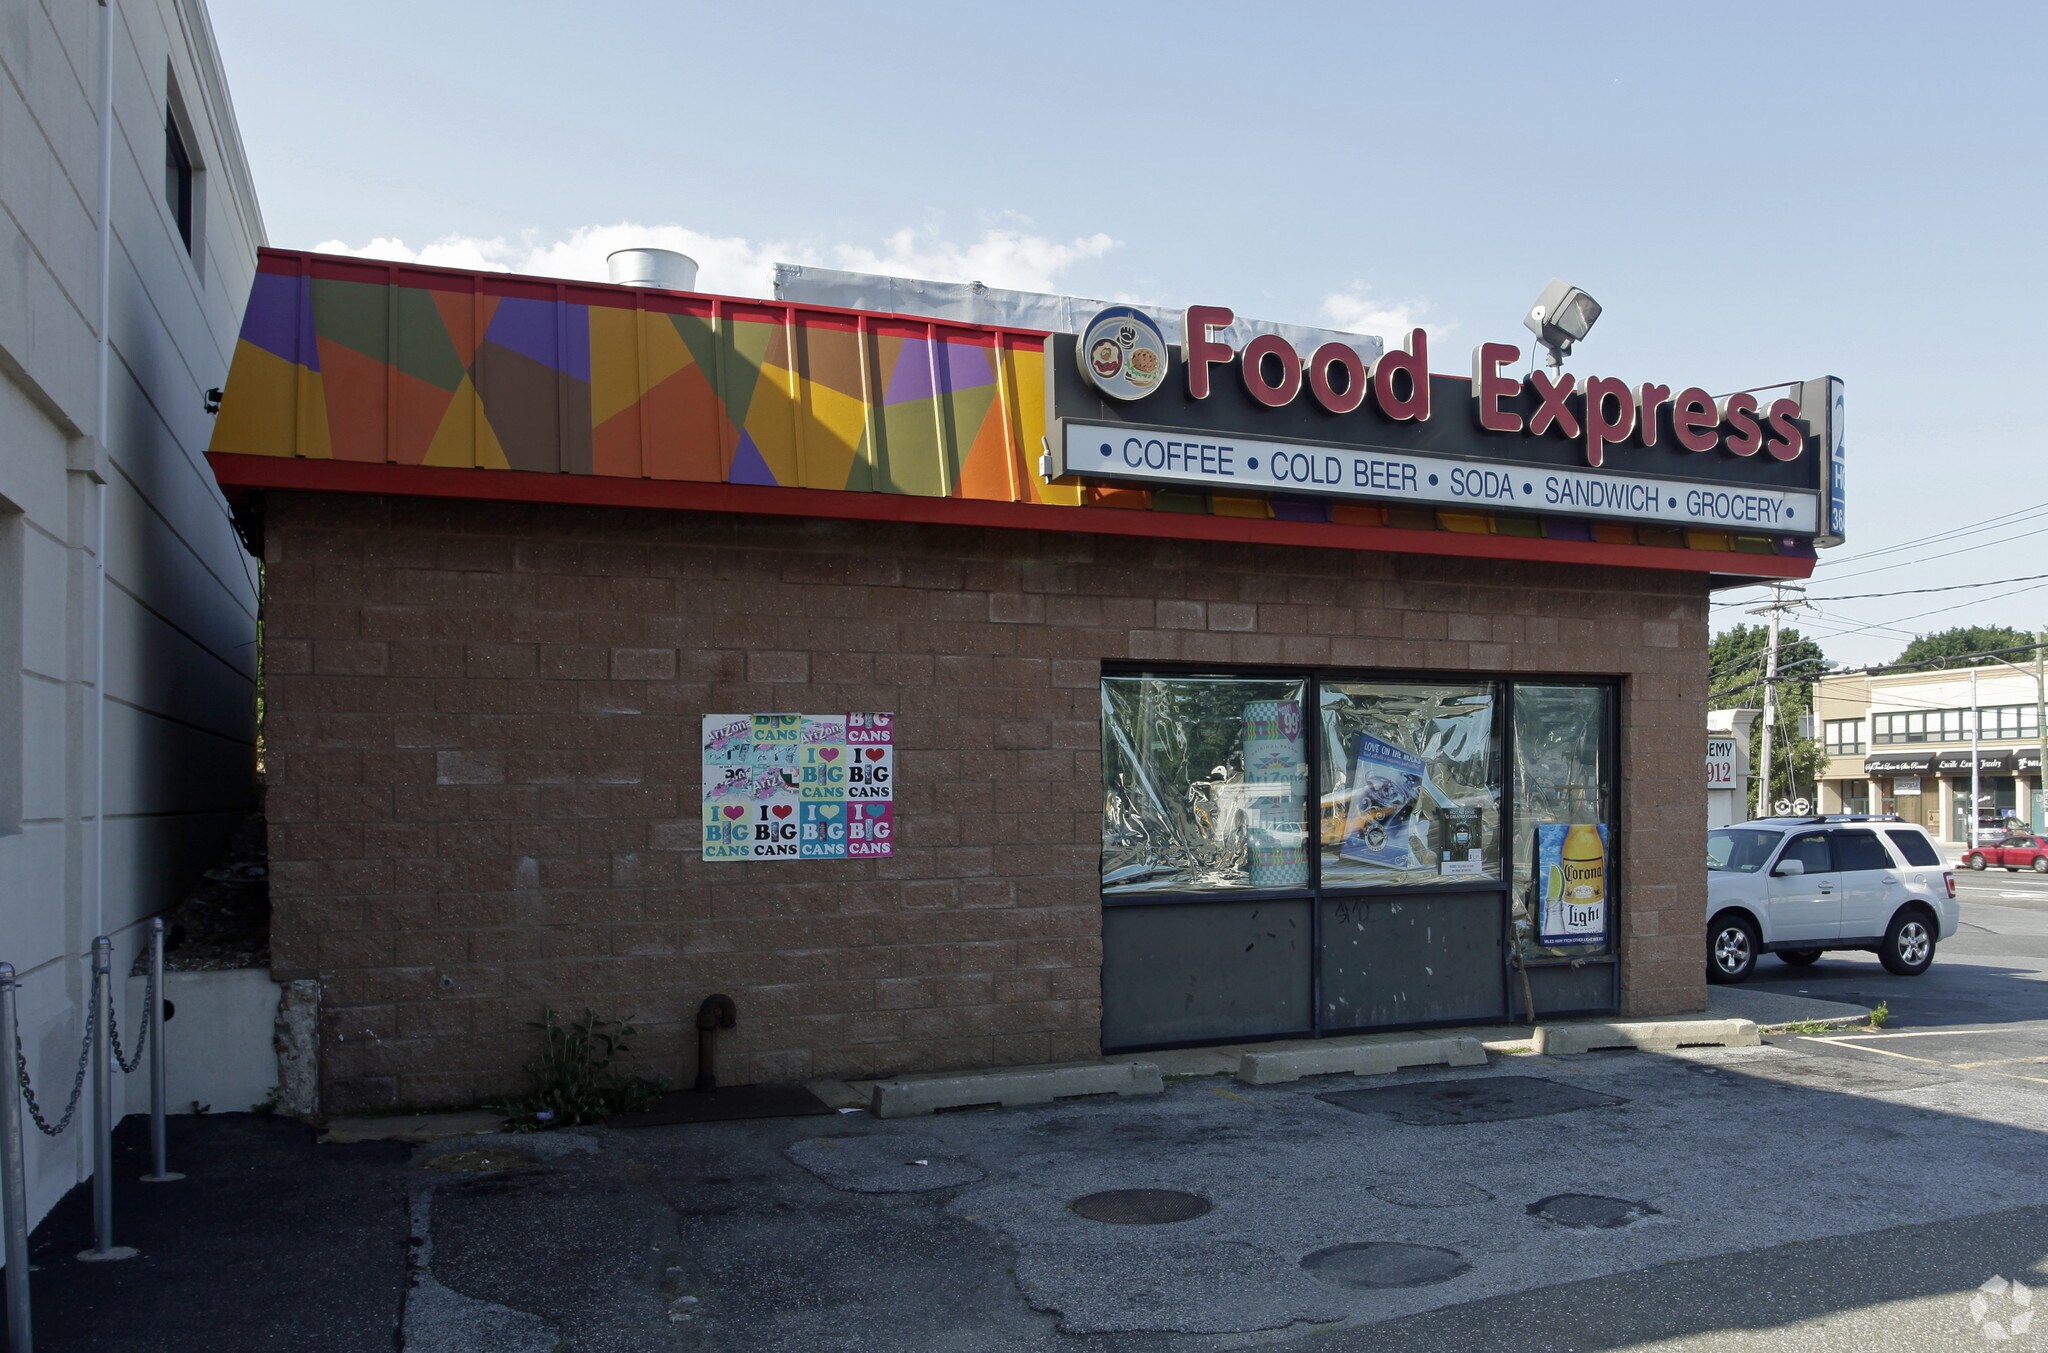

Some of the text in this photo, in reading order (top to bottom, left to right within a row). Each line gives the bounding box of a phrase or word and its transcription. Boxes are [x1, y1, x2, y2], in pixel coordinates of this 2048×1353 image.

[1182, 304, 1803, 468] Food Express
[1122, 437, 1783, 523] COFFEE COLD BEER SODA SANDWICH GROCERY
[754, 730, 797, 741] CANS
[848, 731, 890, 741] CANS
[807, 747, 816, 763] I
[854, 747, 862, 763] I
[1364, 741, 1380, 753] LOVE
[1381, 746, 1391, 755] ON
[1706, 743, 1732, 757] EMY
[802, 765, 843, 785] BIG
[849, 765, 889, 785] BIG
[801, 787, 844, 798] CANS
[848, 787, 890, 798] CANS
[711, 805, 720, 822] I
[760, 805, 769, 821] I
[808, 804, 816, 820] I
[854, 804, 863, 820] I
[706, 823, 749, 843] BIG
[755, 823, 797, 841] BIG
[802, 822, 845, 840] BIG
[849, 821, 891, 840] BIG
[705, 845, 750, 857] CANS
[754, 844, 797, 856] CANS
[801, 843, 845, 855] CANS
[848, 842, 891, 854] CANS
[1564, 863, 1602, 884] Corona
[1568, 904, 1600, 927] Light
